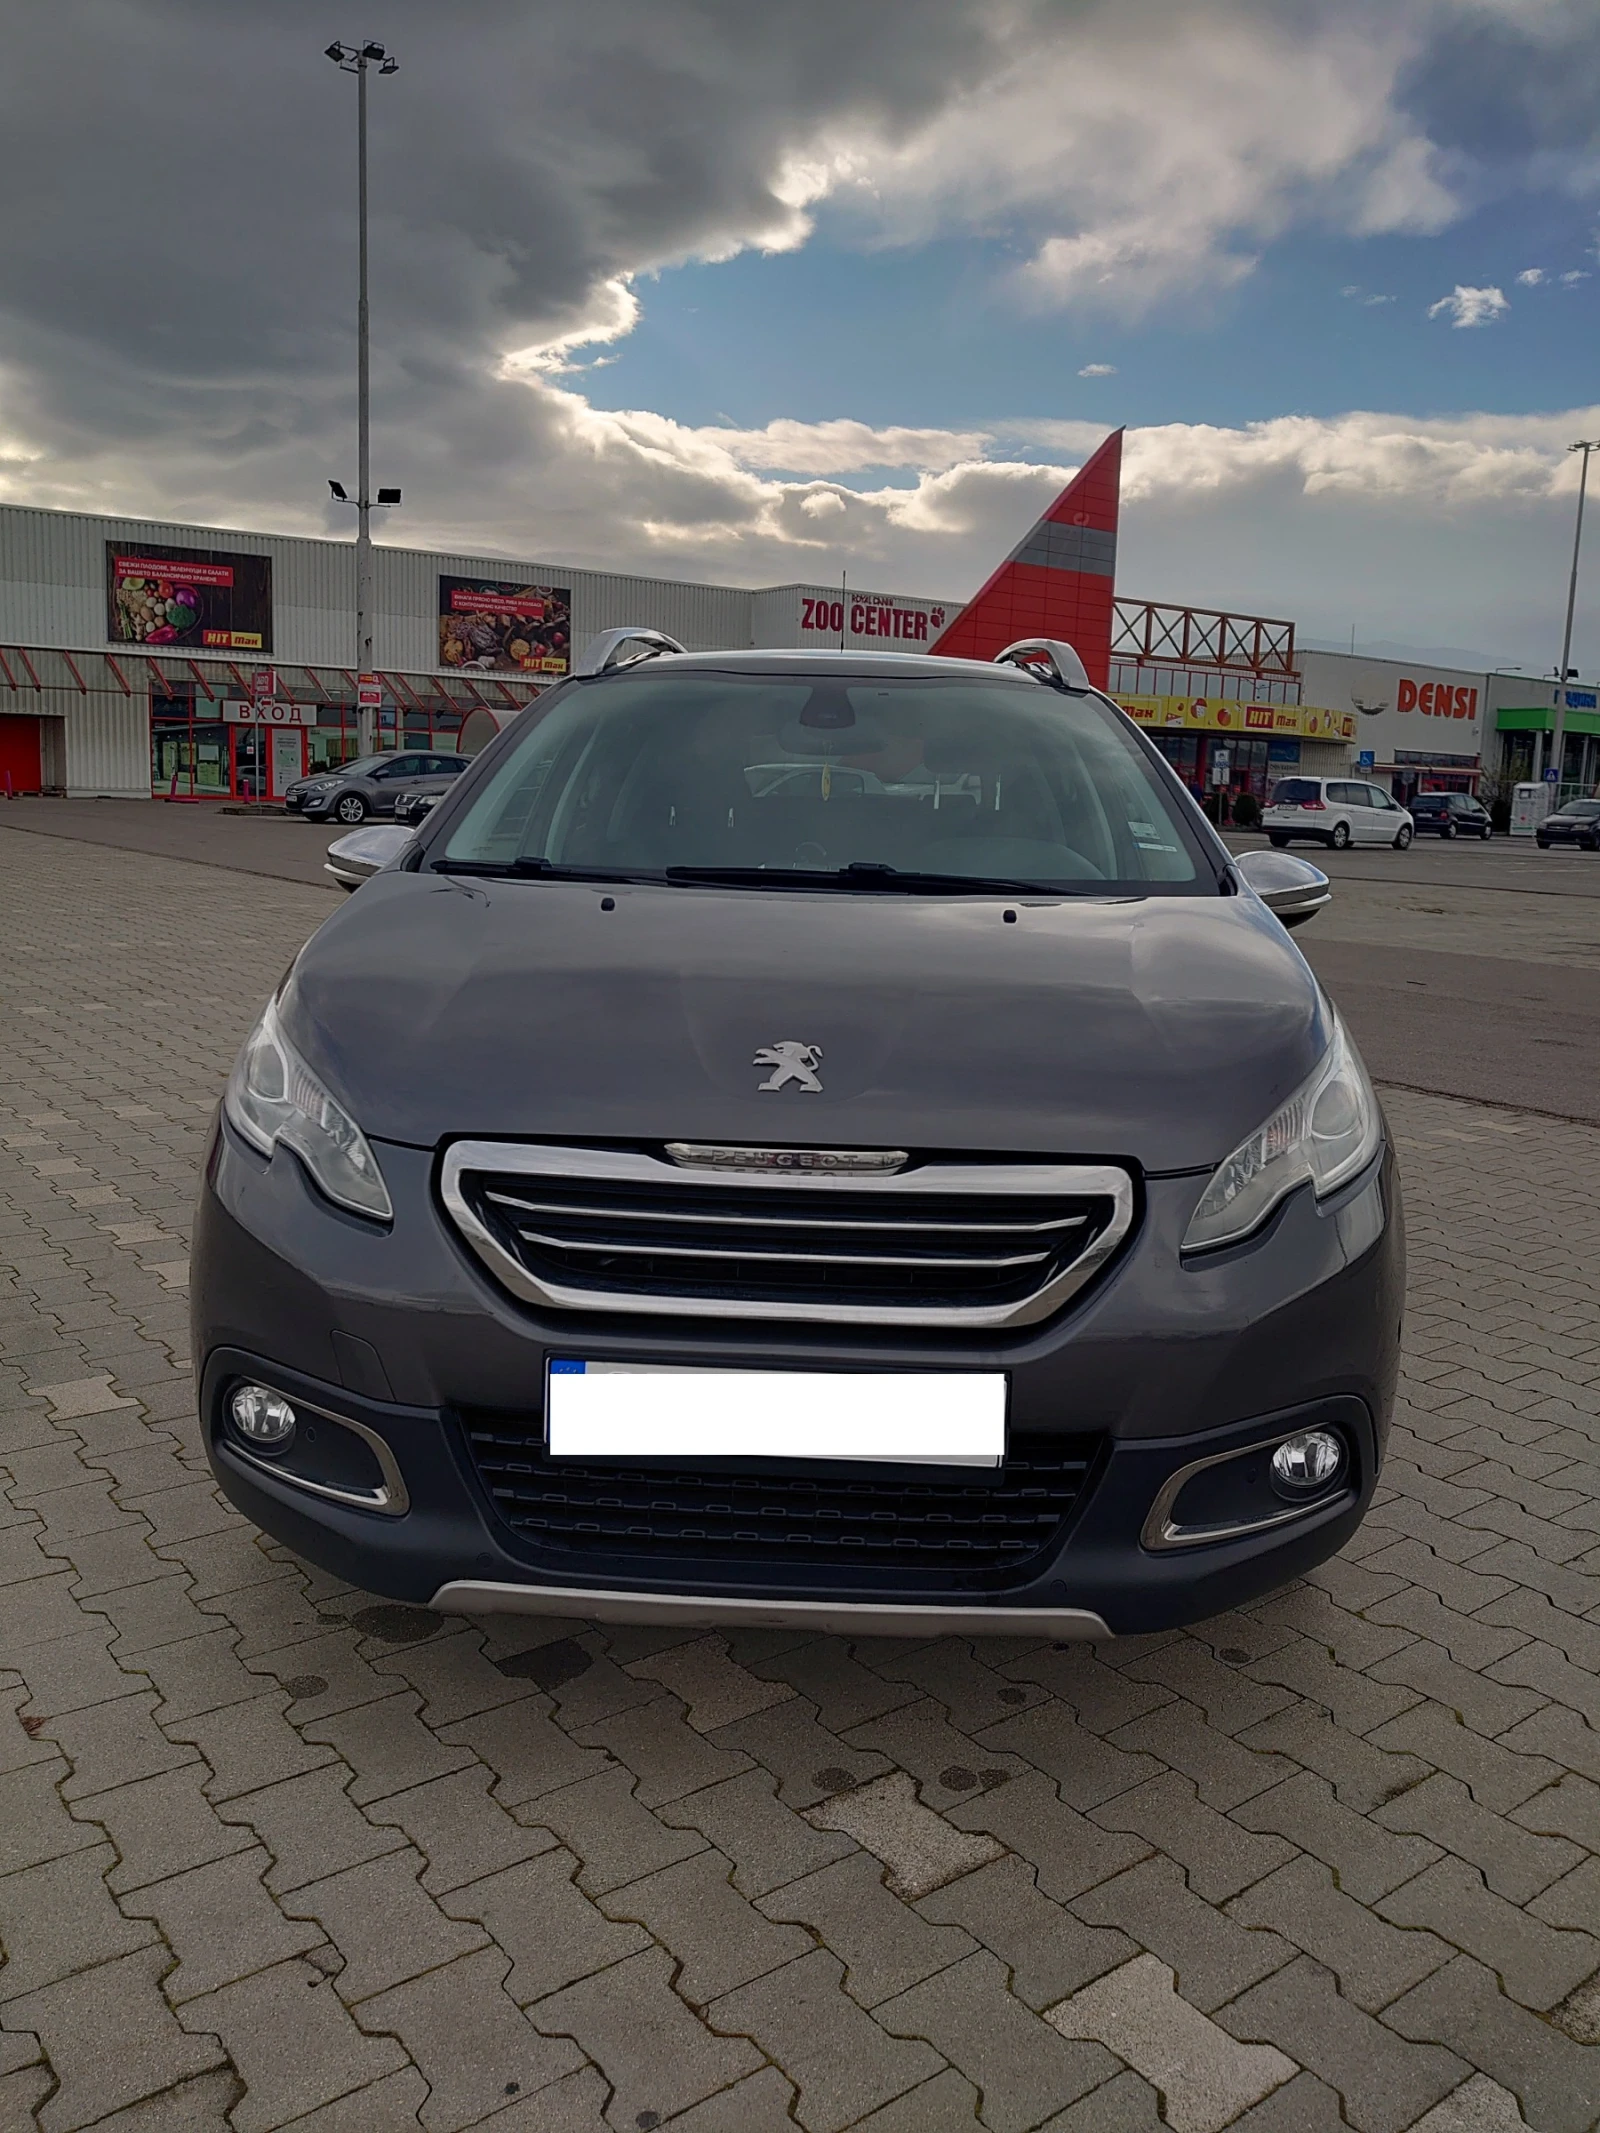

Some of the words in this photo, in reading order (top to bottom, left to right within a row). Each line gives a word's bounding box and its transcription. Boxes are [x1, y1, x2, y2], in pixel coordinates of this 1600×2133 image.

[801, 598, 844, 632] ZOO
[850, 604, 928, 641] CENTER
[207, 632, 229, 644] HIT
[524, 658, 541, 668] HIT
[1397, 678, 1478, 720] DENSI
[239, 706, 302, 724] ВХОД
[1248, 710, 1272, 726] HIT
[711, 1149, 858, 1168] PEUGEOT
